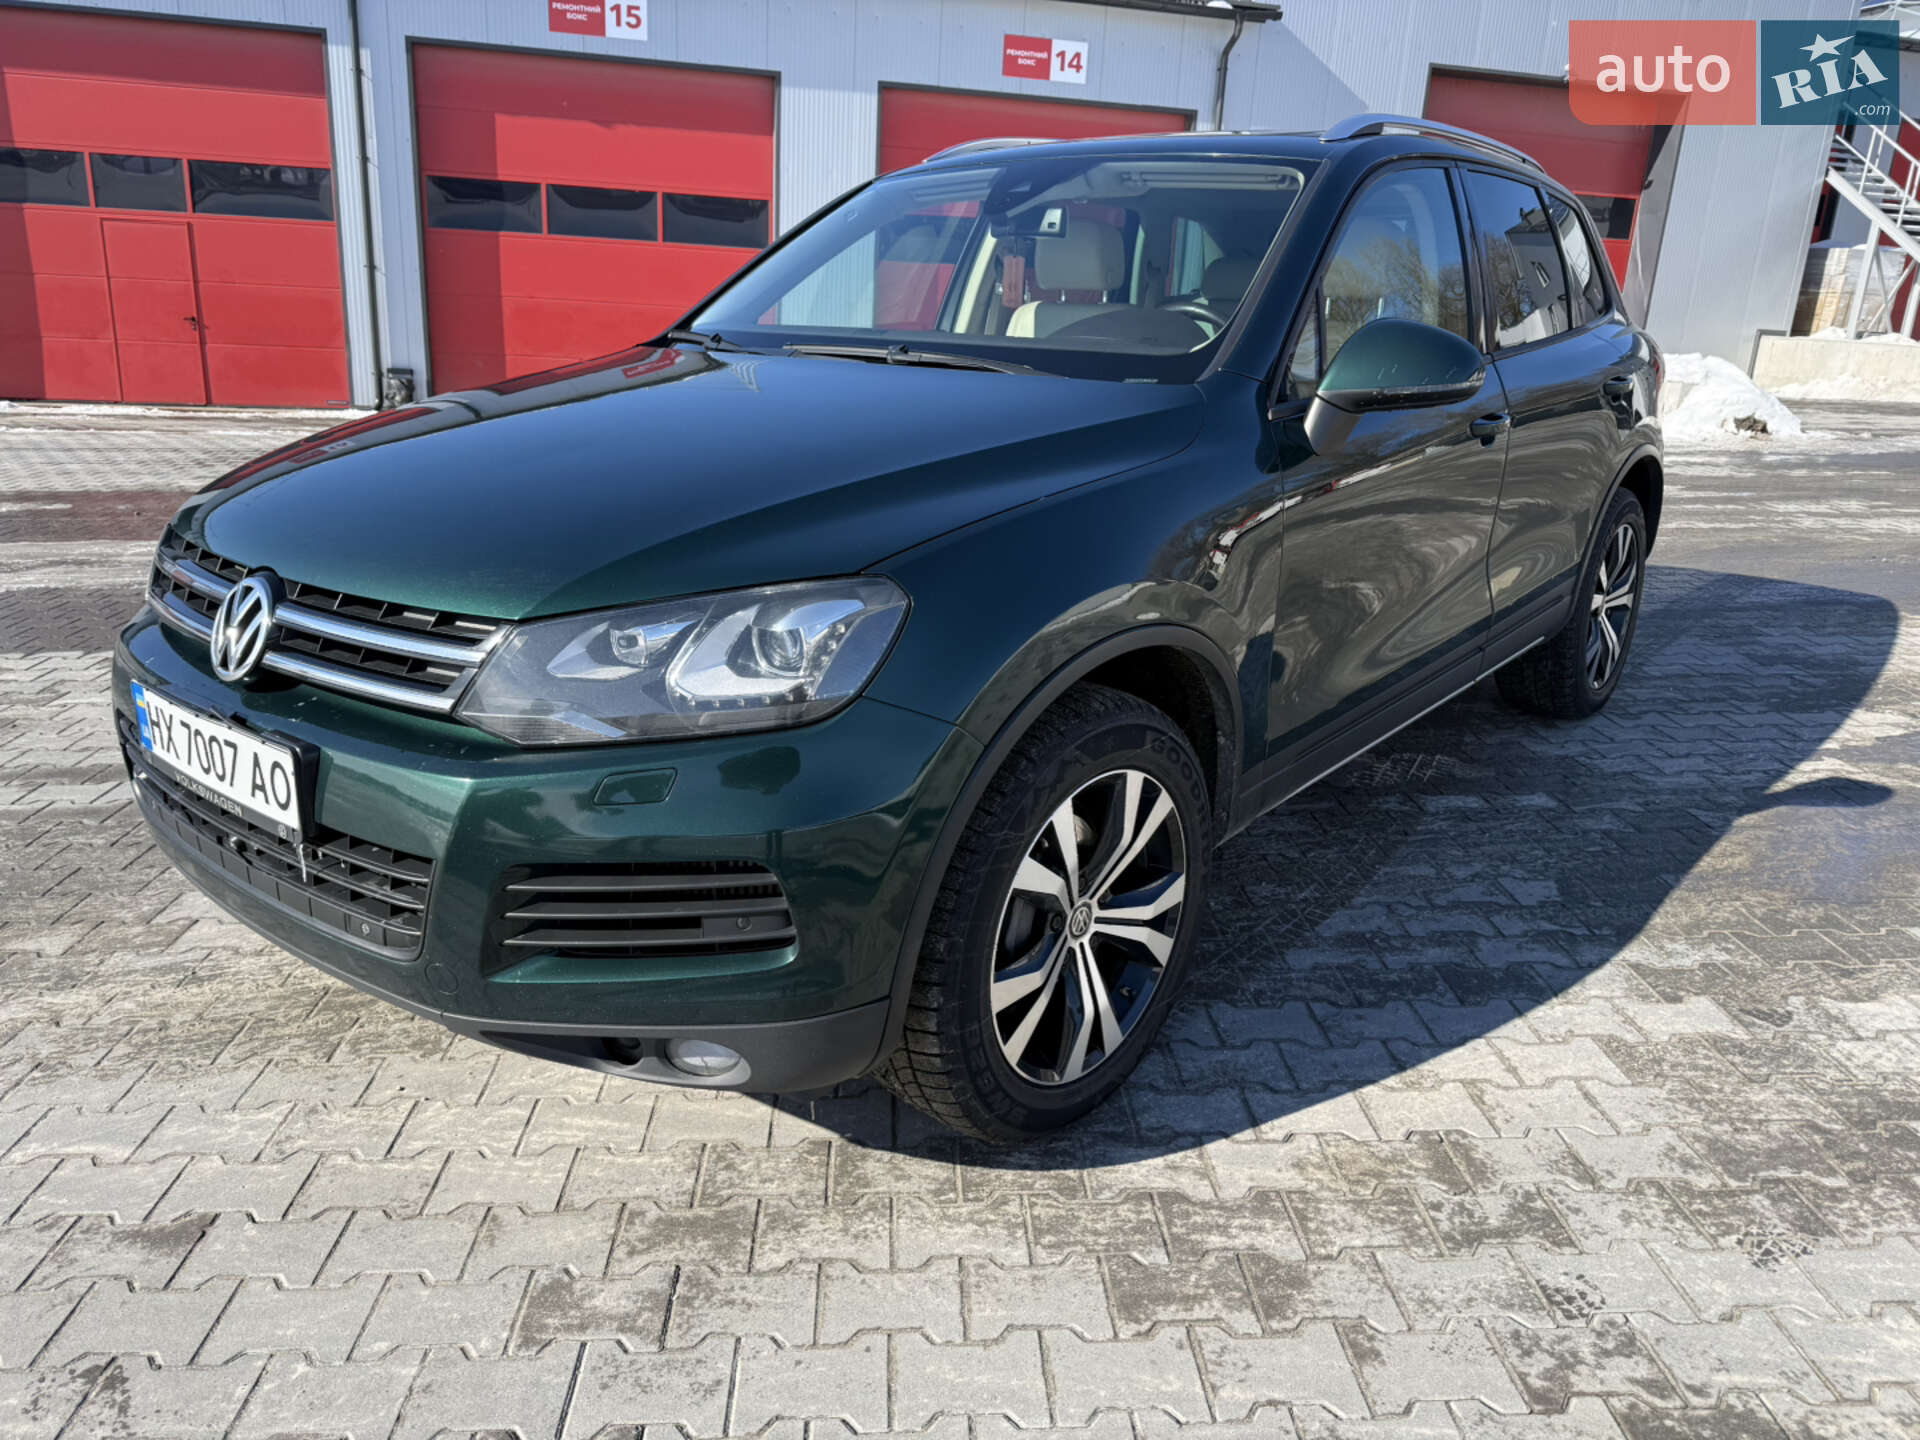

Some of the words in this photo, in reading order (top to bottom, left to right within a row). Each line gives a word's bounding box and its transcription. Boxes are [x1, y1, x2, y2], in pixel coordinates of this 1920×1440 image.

[566, 12, 588, 21] БОКС
[609, 4, 642, 29] 15
[1056, 50, 1083, 73] 14
[147, 701, 179, 760] HX
[180, 719, 238, 787] 7007
[251, 752, 291, 811] AO
[174, 772, 243, 817] VOLKSWAGEN
